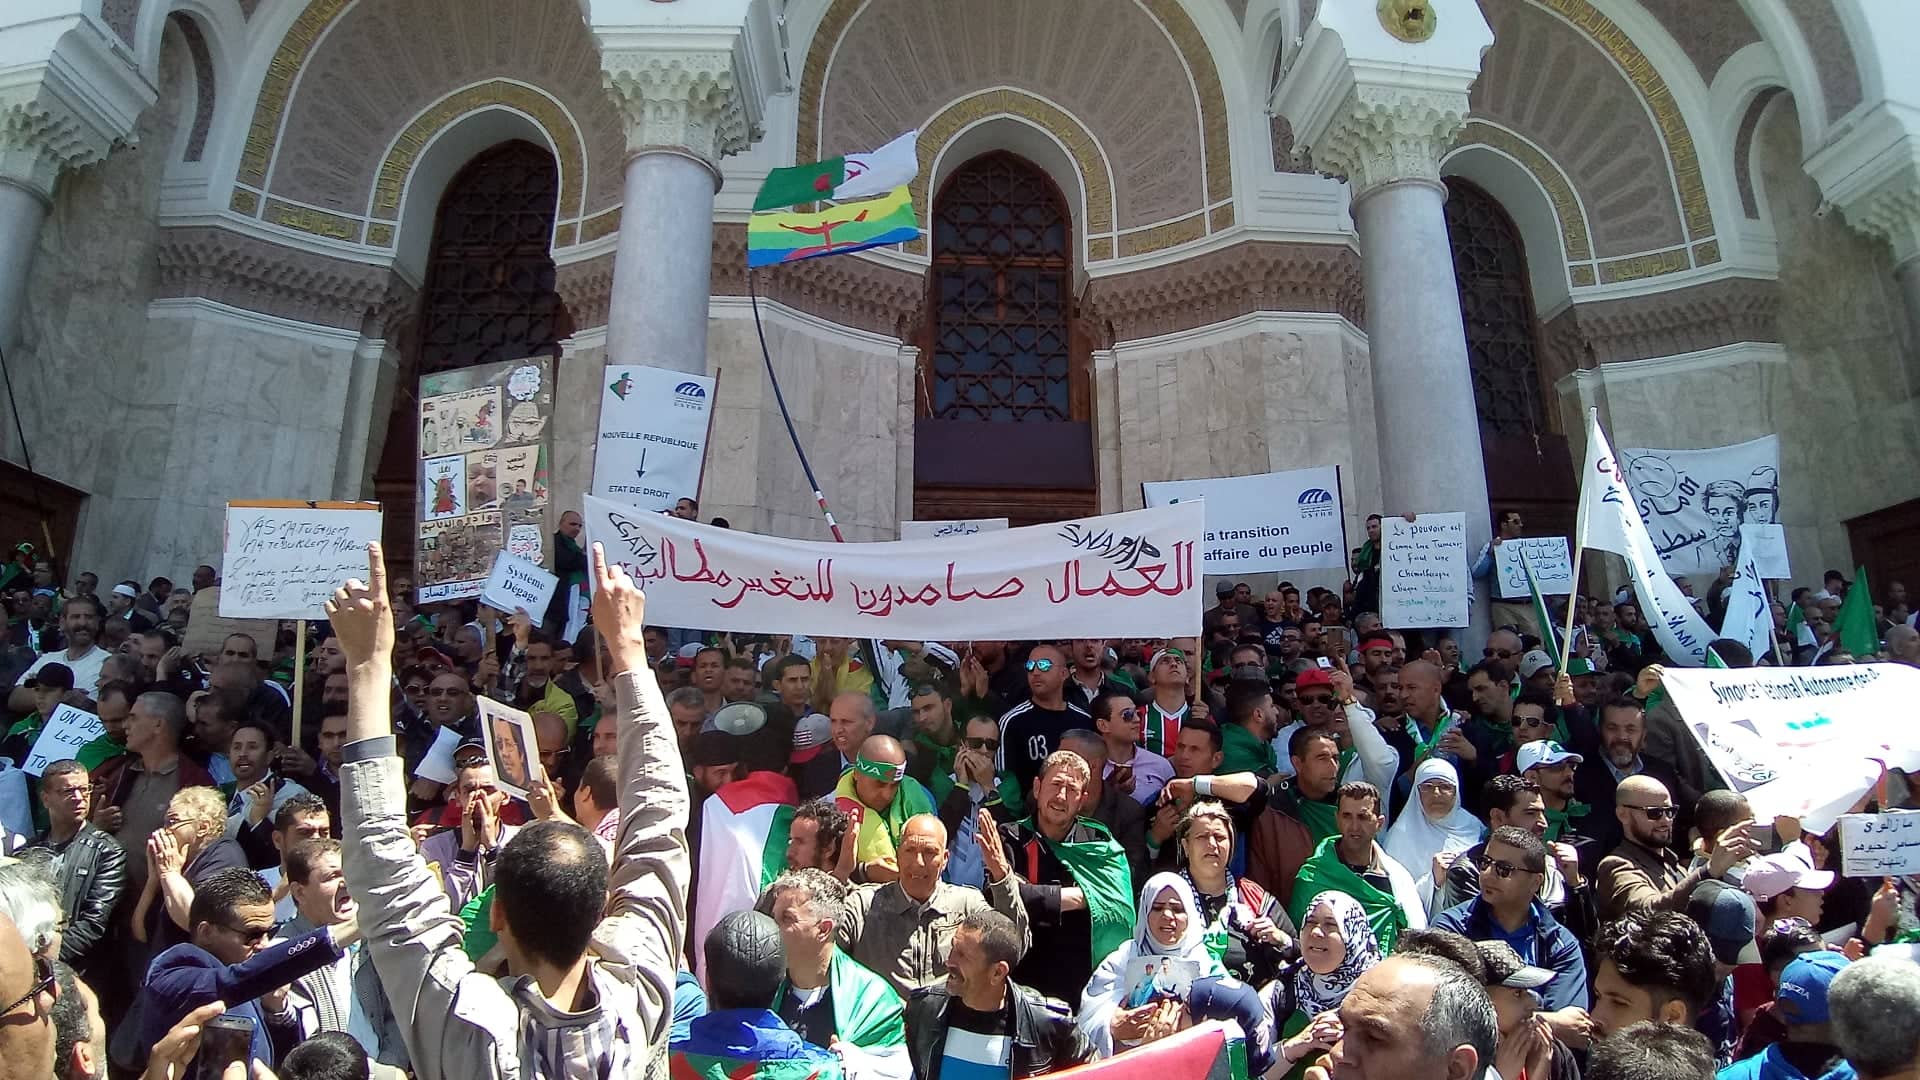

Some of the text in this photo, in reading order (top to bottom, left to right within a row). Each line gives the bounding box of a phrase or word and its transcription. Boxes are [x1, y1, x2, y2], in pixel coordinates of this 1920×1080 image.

[602, 431, 699, 450] NOUVELLE REPUBLIQUE
[608, 485, 671, 500] ETAT DE DROIT
[1219, 525, 1290, 541] transition
[1410, 525, 1446, 539] pouvoir
[1258, 545, 1278, 558] du
[1282, 541, 1333, 558] peuple
[1045, 540, 1194, 603] العمال
[502, 579, 538, 603] Dégage
[848, 561, 1025, 617] صامدون
[1799, 671, 1856, 697] Autonome
[60, 710, 81, 725] ON
[54, 729, 70, 743] LE
[1028, 734, 1049, 761] 03
